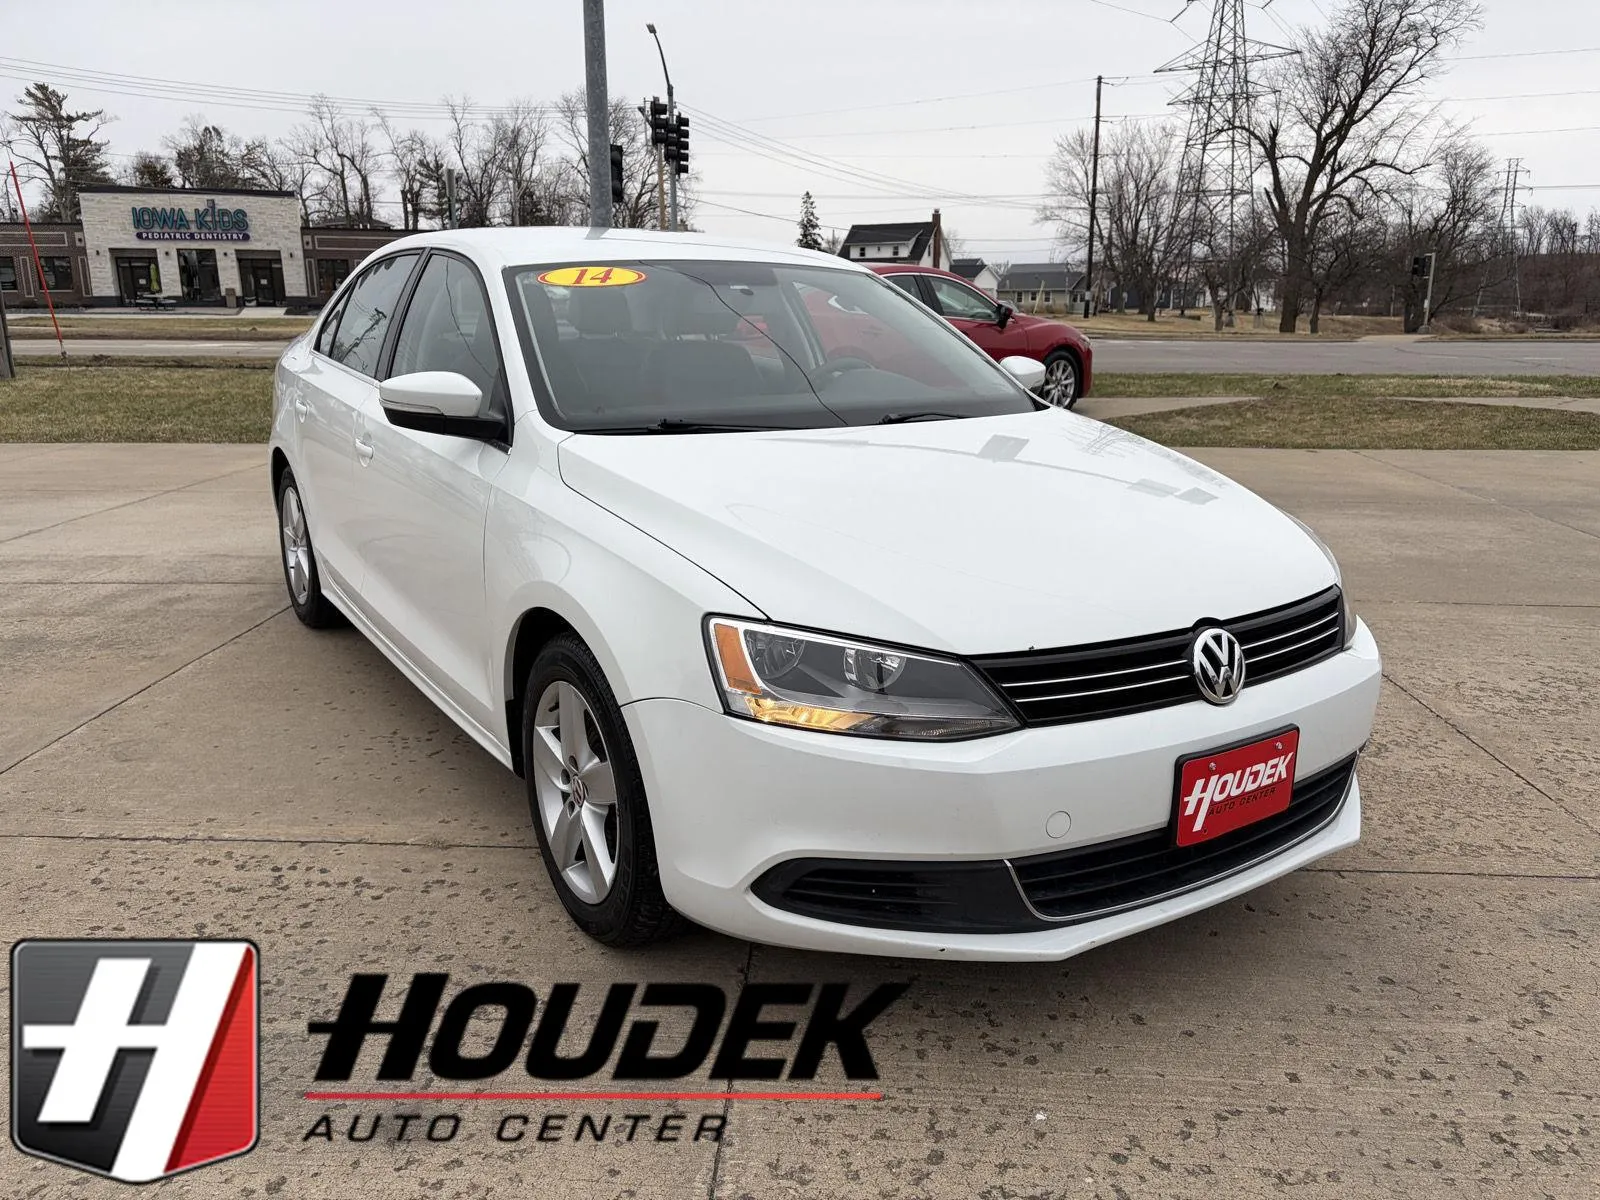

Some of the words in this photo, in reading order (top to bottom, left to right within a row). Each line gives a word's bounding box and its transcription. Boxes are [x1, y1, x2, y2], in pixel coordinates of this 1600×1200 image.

[131, 206, 190, 230] IOWA
[194, 199, 249, 231] KIDS
[142, 232, 191, 240] PEDIATRIC
[194, 232, 244, 240] DENTISTRY
[572, 267, 613, 284] 14
[1184, 752, 1294, 832] HOUDEK
[1208, 801, 1236, 816] AUTO
[1239, 787, 1277, 807] CENTER
